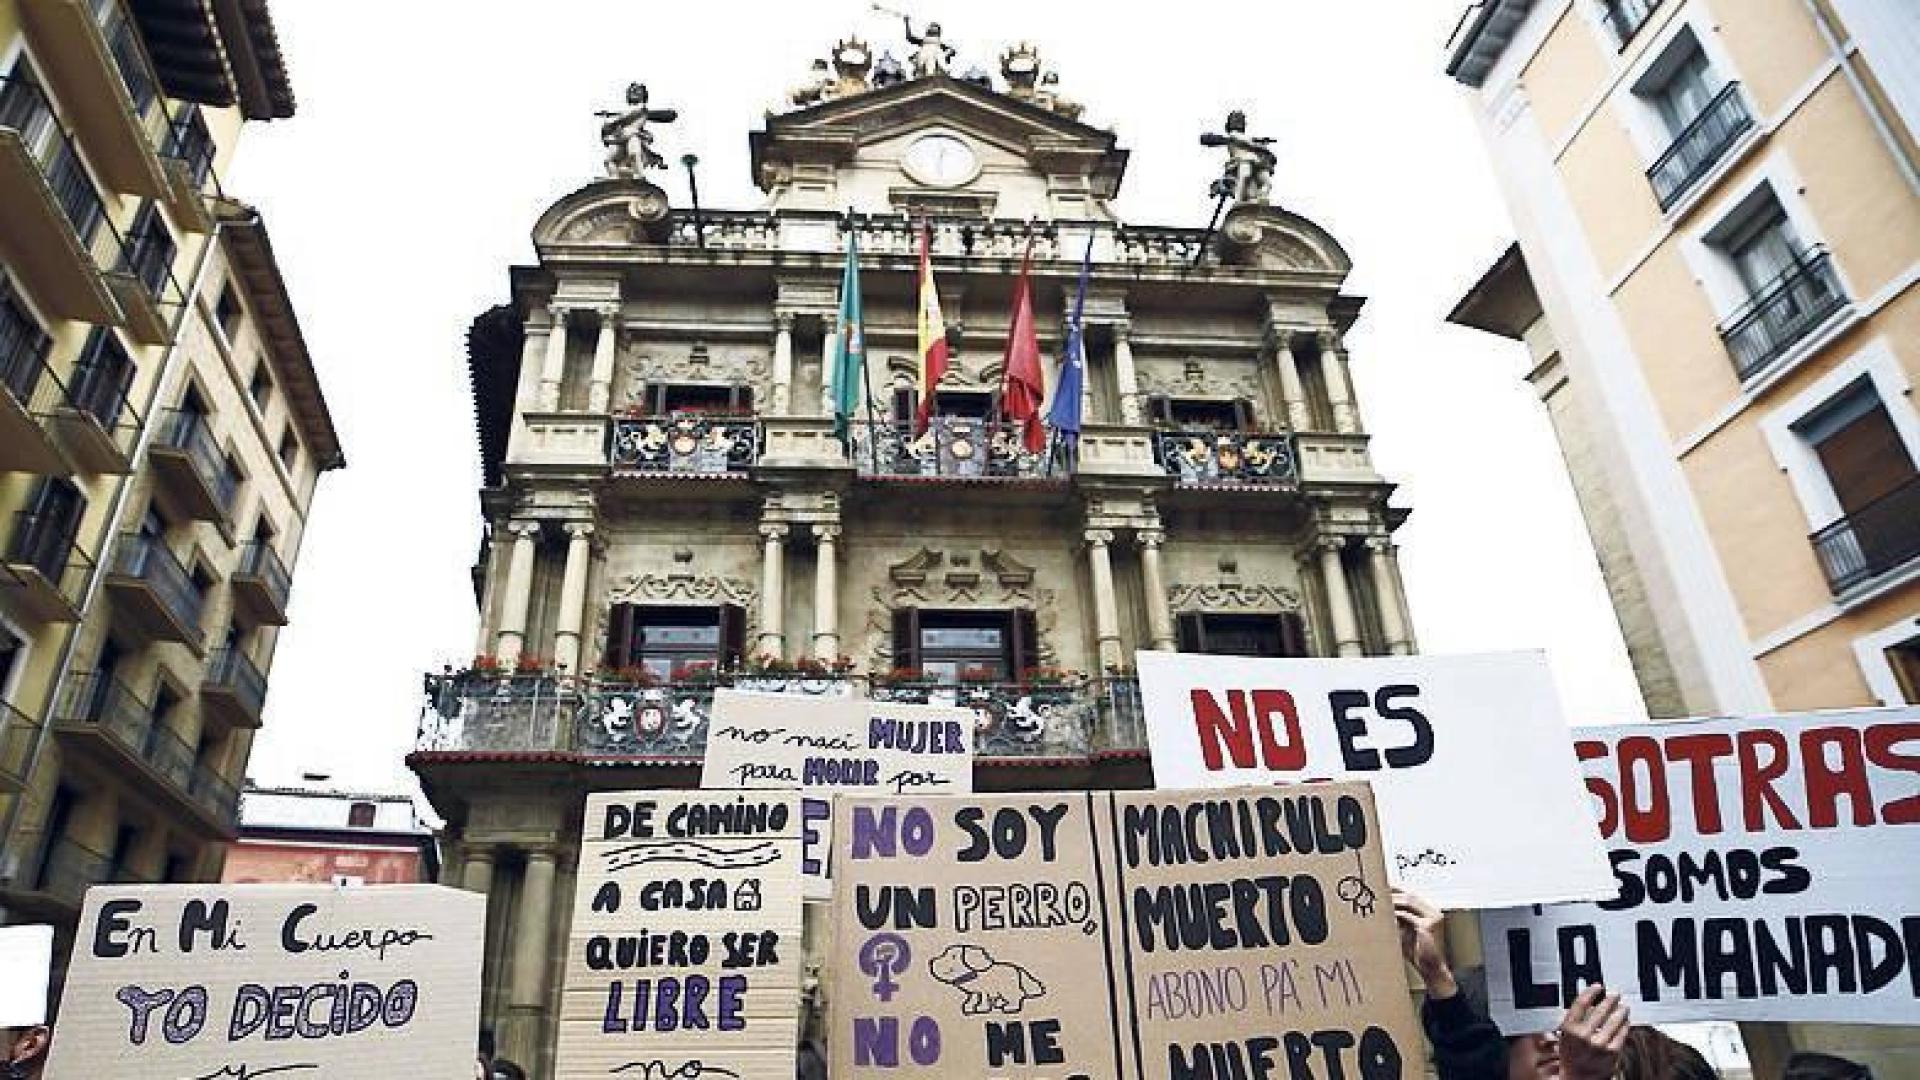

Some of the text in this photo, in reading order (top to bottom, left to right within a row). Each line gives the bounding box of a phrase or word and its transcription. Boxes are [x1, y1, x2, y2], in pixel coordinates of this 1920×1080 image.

[715, 726, 786, 744] no
[868, 717, 966, 754] MUJER
[1190, 685, 1435, 771] NO ES
[729, 757, 951, 793] para MORIR por
[604, 796, 788, 839] DE CAMINO
[851, 806, 934, 859] NO
[955, 802, 1070, 863] SOY
[1124, 795, 1366, 869] MACHIRULO
[591, 878, 728, 914] A CASA
[856, 881, 1098, 936] UN PERRO,
[1597, 846, 1812, 911] SOMOS
[93, 900, 433, 960] En Mi Cuerpo
[1134, 874, 1328, 952] MUERTO
[586, 929, 779, 970] QUIERO SER
[1507, 924, 1606, 1009] LA
[116, 970, 417, 1045] YO DECIDO
[603, 974, 748, 1033] LIBRE
[1148, 966, 1248, 1020] ABONO
[1315, 959, 1363, 1008] MI
[853, 1016, 1065, 1066] NO ME
